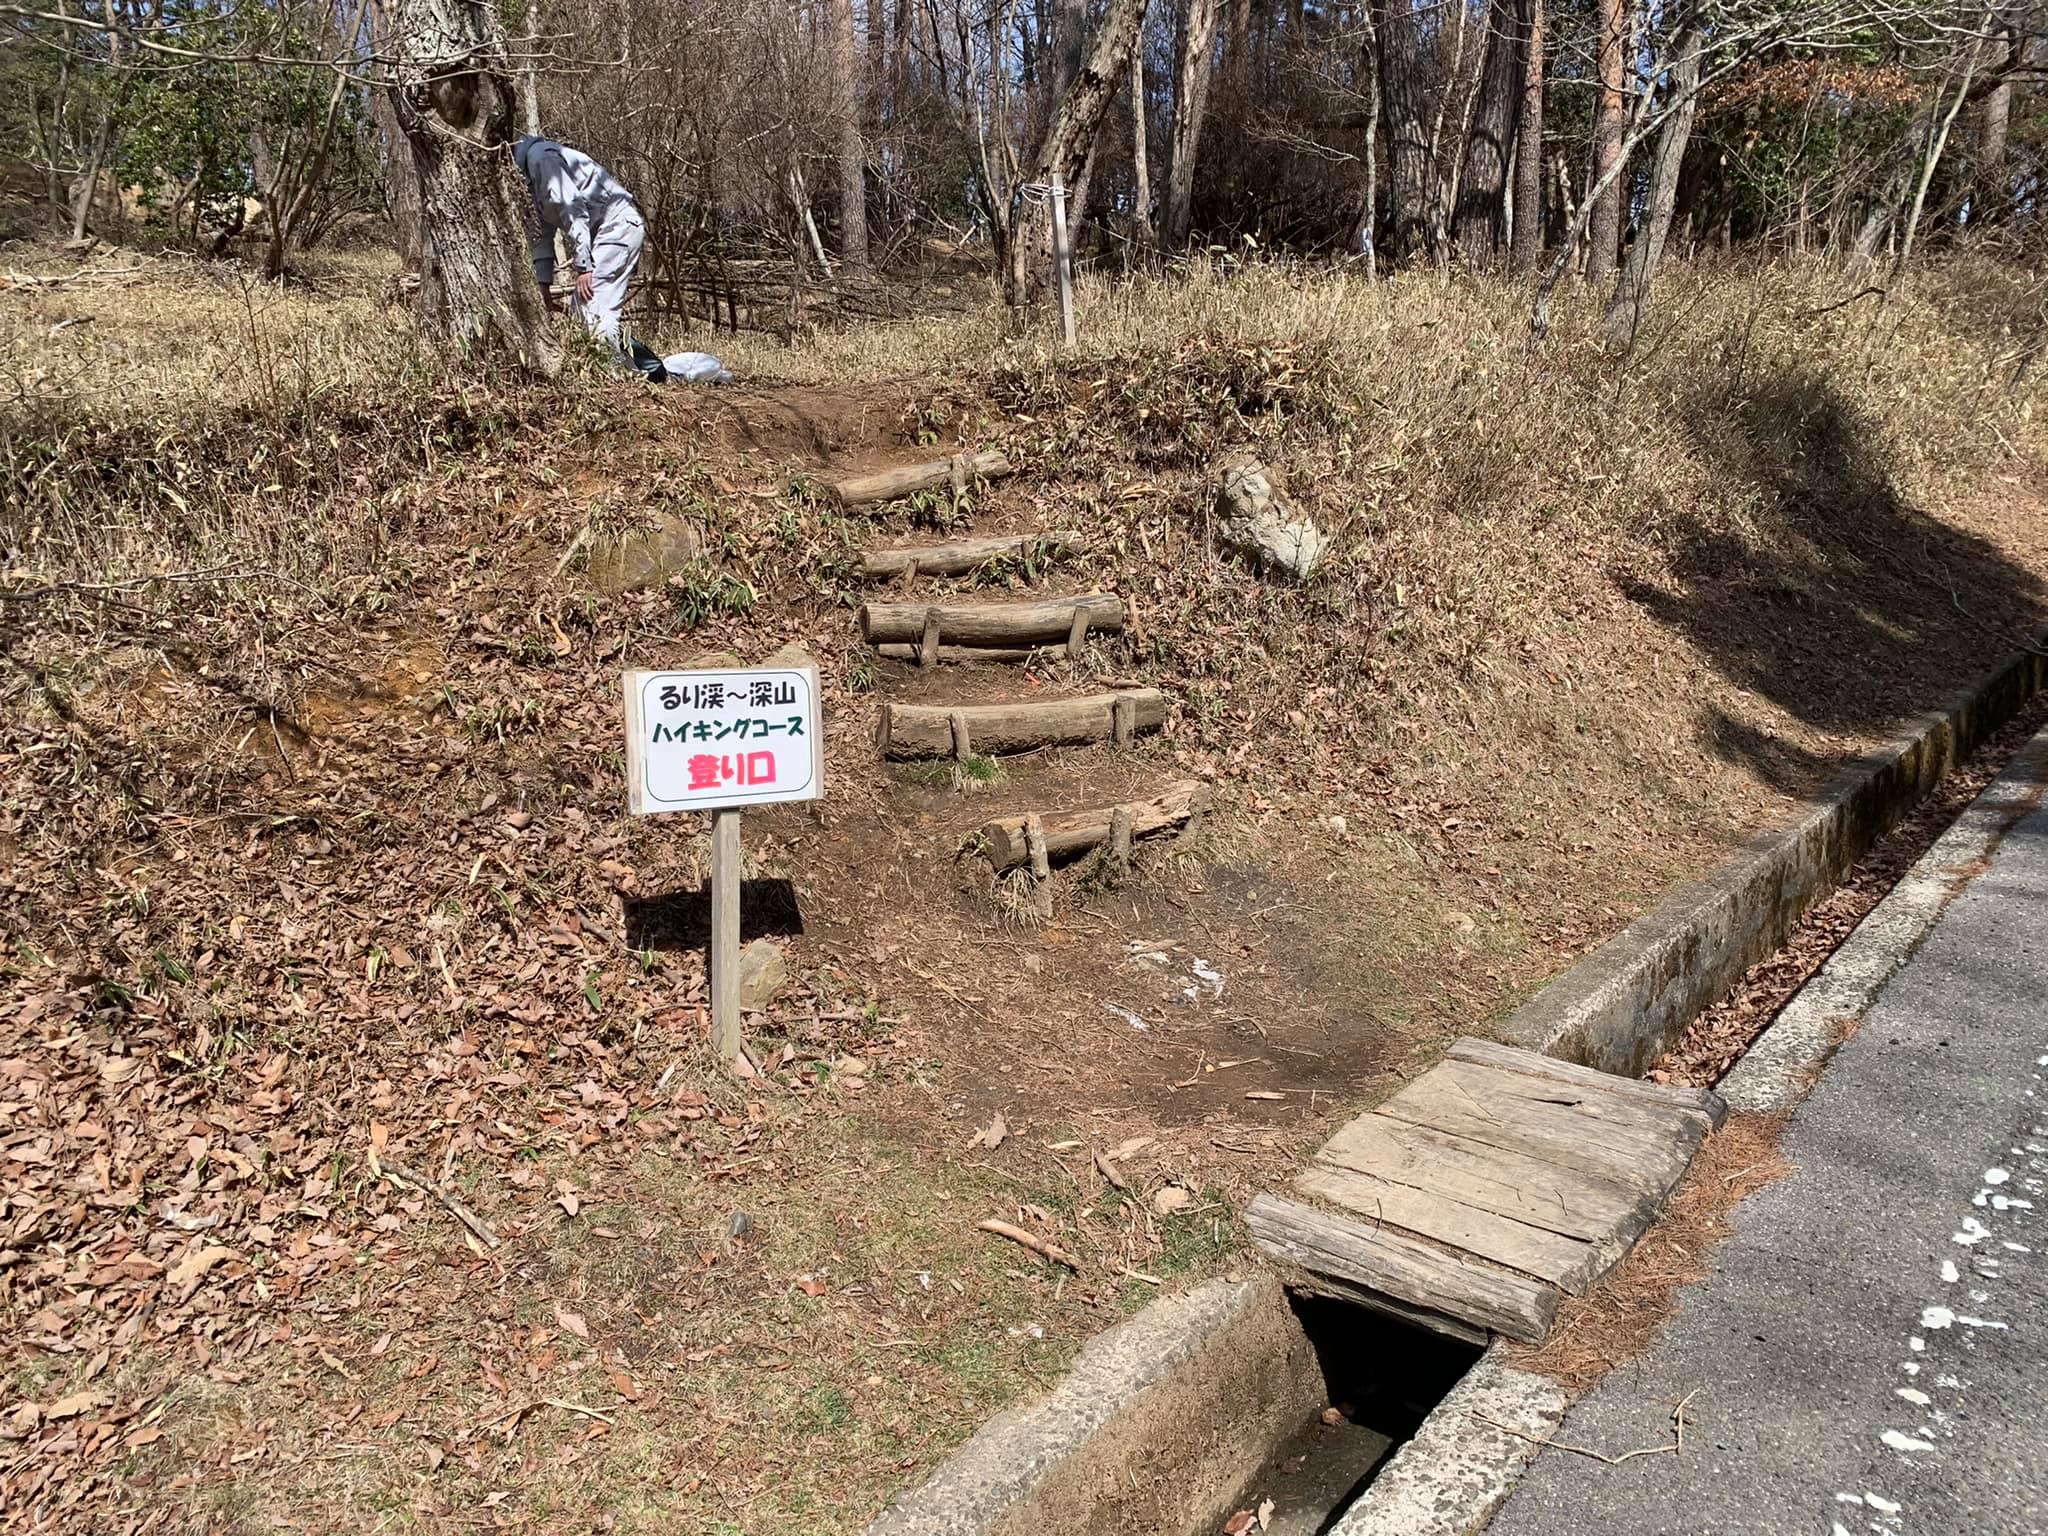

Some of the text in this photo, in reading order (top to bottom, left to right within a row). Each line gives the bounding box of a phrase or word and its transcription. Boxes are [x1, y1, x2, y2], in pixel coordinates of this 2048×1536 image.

[652, 716, 805, 743] ハイキングコース
[687, 750, 777, 791] 登り口
